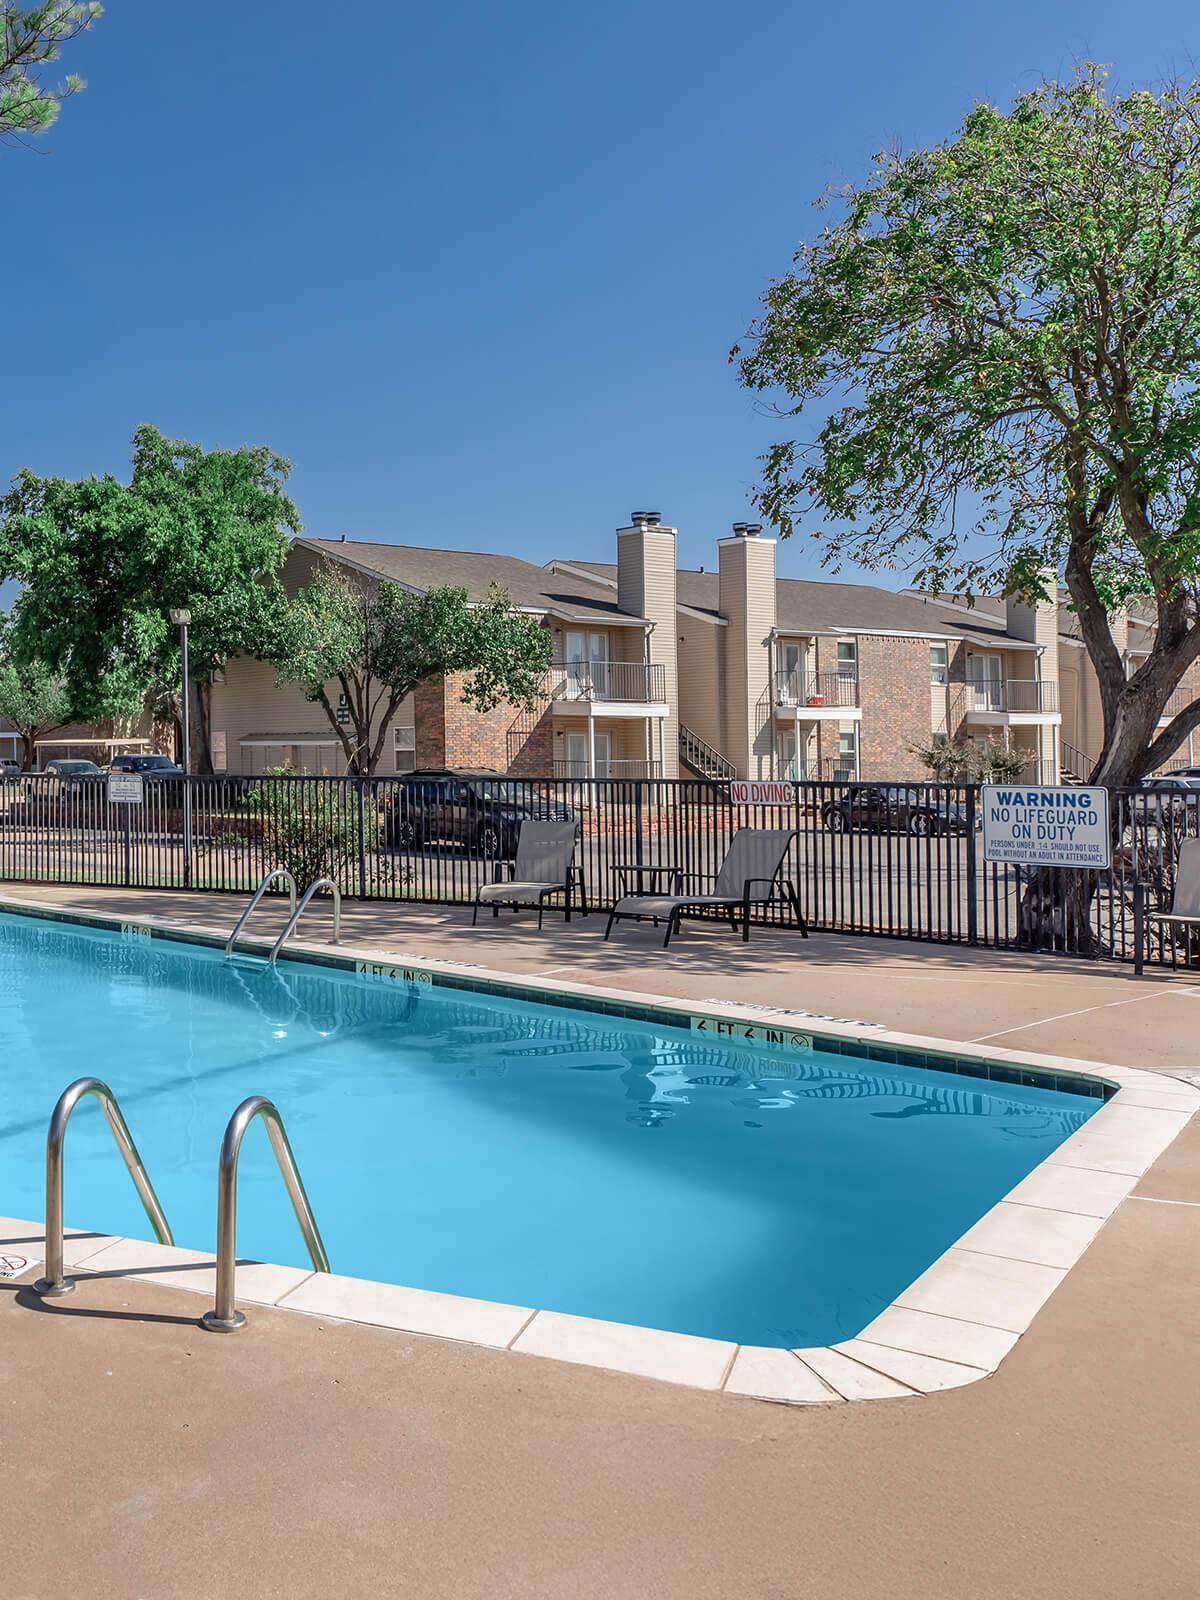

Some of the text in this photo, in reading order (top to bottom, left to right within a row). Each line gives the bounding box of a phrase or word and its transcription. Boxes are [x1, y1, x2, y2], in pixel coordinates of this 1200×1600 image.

[732, 783, 792, 802] NO DIVING
[996, 791, 1092, 808] WARNING
[991, 807, 1098, 826] NO LIFEGUARD
[1012, 824, 1076, 841] ON DUTY
[990, 840, 1015, 849] PERSONS
[1017, 841, 1035, 849] UNDER
[1051, 843, 1073, 851] SHOULD
[1075, 844, 1087, 852] NOT
[1088, 844, 1100, 853] USE
[988, 849, 1103, 863] POOL WITHOUT AN ADULT IN ATTENDANCE
[404, 970, 415, 981] IN
[717, 1022, 734, 1035] FT
[766, 1030, 784, 1044] IN
